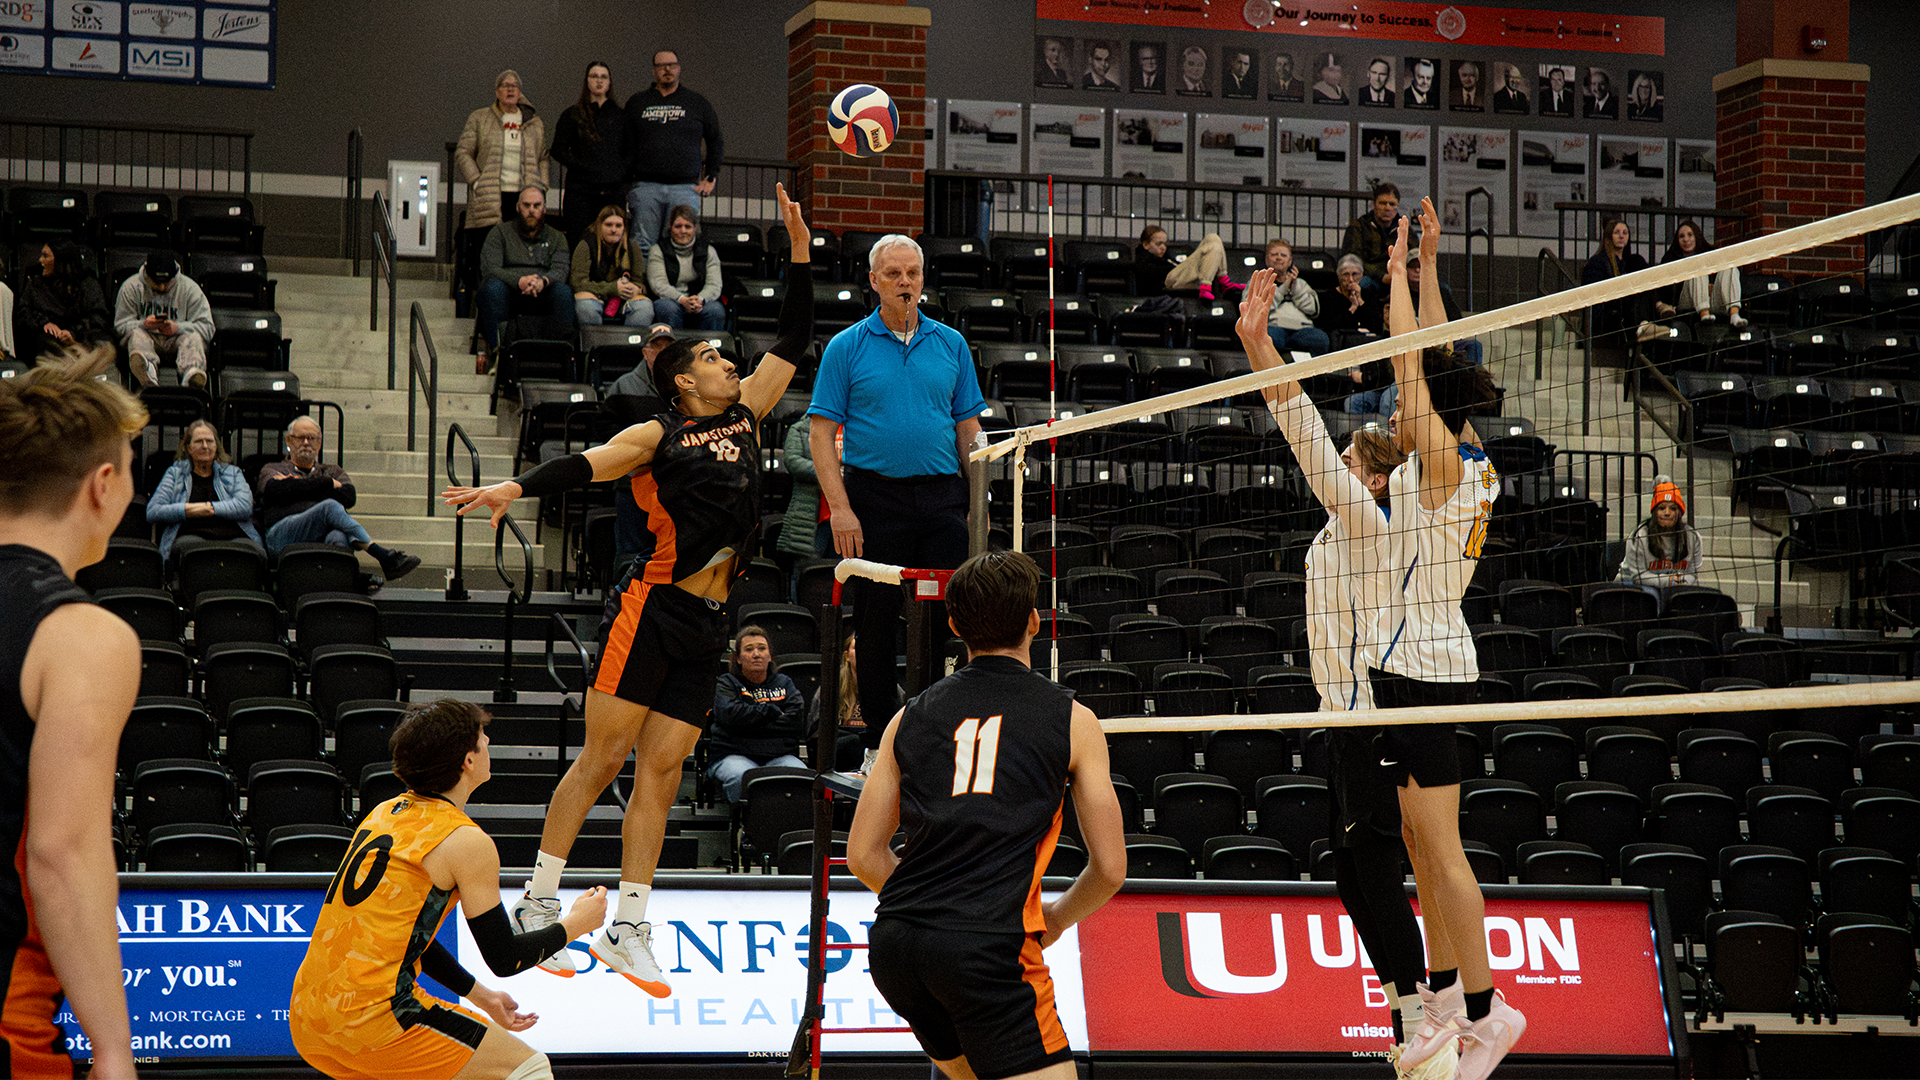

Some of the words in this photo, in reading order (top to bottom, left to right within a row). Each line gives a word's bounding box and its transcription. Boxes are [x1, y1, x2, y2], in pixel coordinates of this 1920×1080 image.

[1275, 7, 1299, 19] Our
[1304, 9, 1356, 25] Journey
[1361, 13, 1374, 24] to
[133, 48, 190, 67] MSI
[951, 714, 1003, 797] 11
[324, 829, 394, 907] 10
[178, 899, 306, 933] BANK
[161, 966, 237, 995] you.
[1515, 974, 1557, 984] Member
[1560, 975, 1582, 984] FDIC
[149, 1009, 247, 1023] MORTGAGE
[1351, 1050, 1392, 1058] DAKTRO
